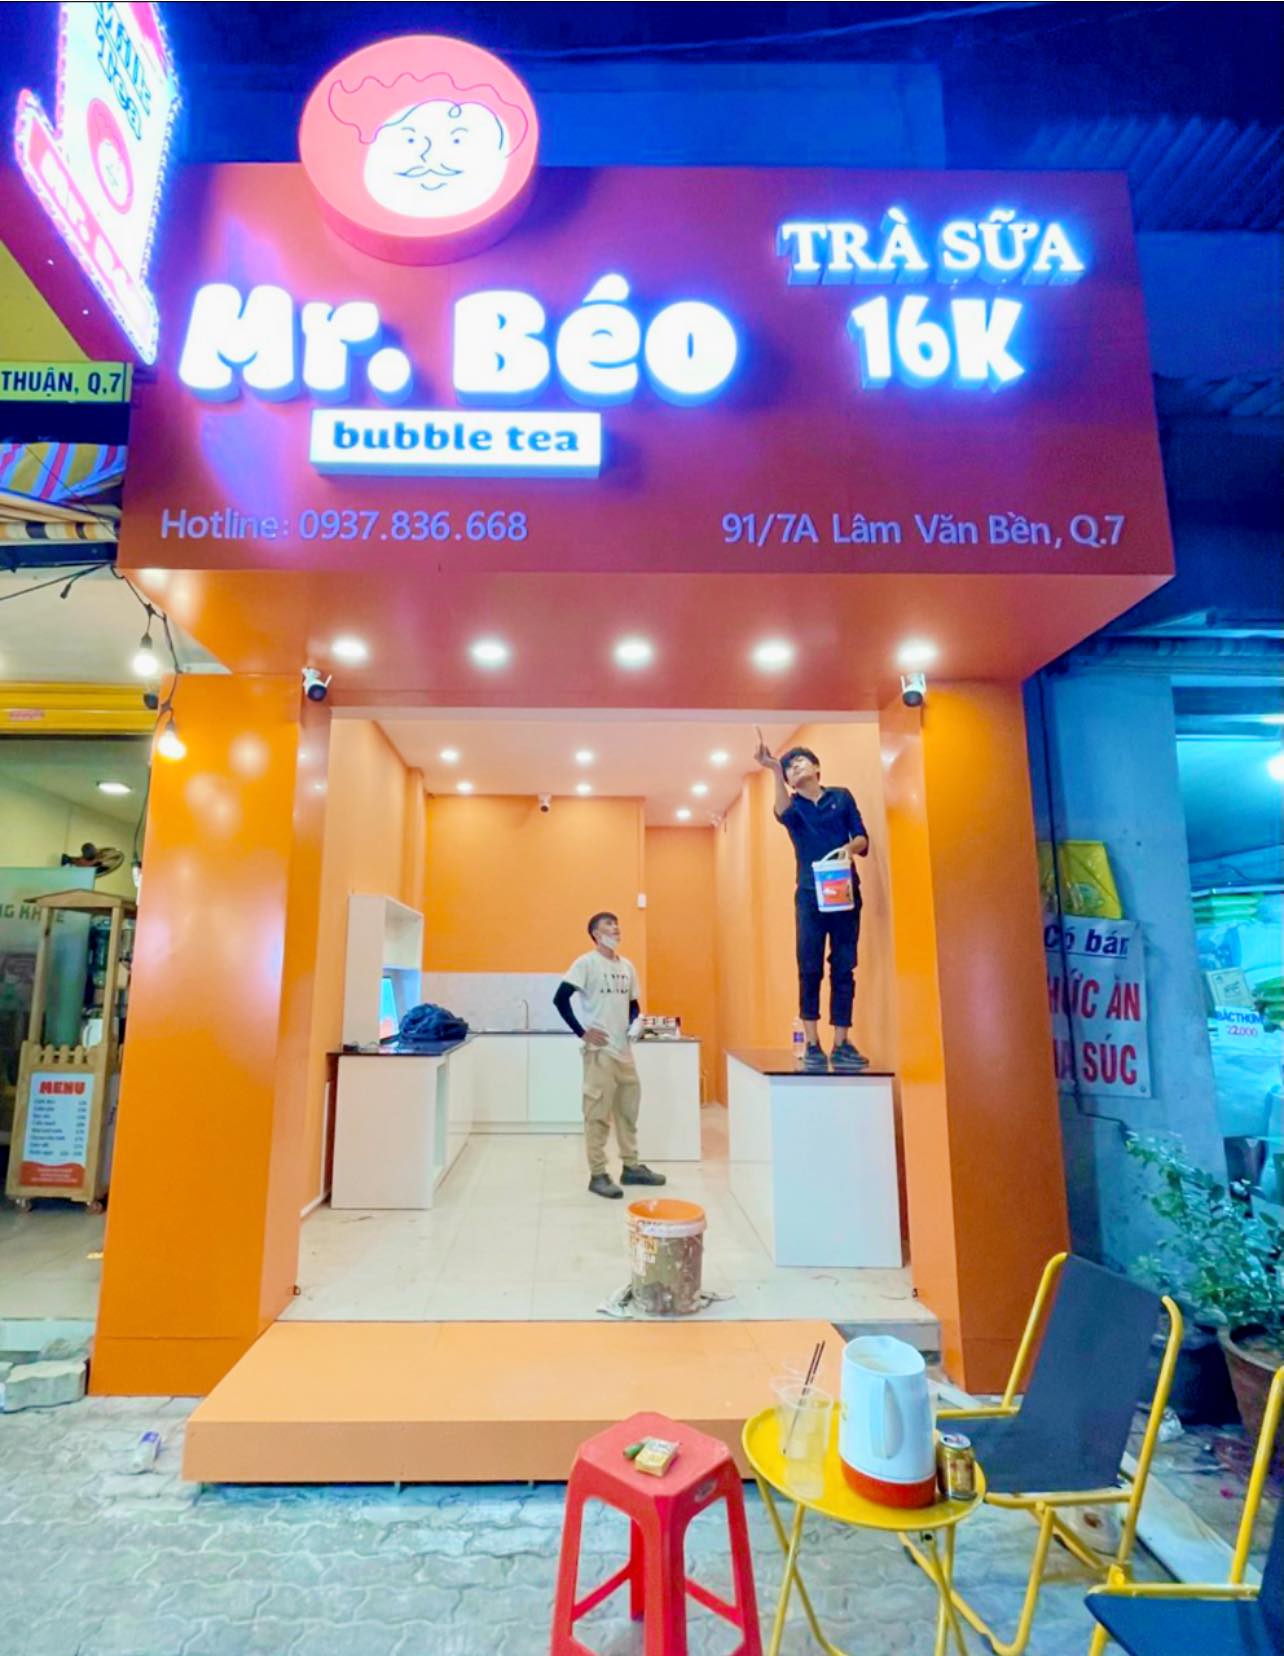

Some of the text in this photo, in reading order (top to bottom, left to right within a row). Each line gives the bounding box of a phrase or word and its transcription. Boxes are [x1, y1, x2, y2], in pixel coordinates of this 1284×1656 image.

[781, 206, 1085, 272] TRÀ SỮA
[178, 272, 737, 394] Mr. Béo
[851, 295, 1026, 382] 16K
[0, 367, 80, 397] THUẬN,
[333, 420, 580, 452] bubble tea
[159, 507, 529, 542] Hotline: 0937.836.668
[721, 511, 1126, 550] 91/7A Lâm Văn Bền, Q.7
[1083, 1033, 1138, 1086] SÚC
[39, 1080, 86, 1096] MENU
